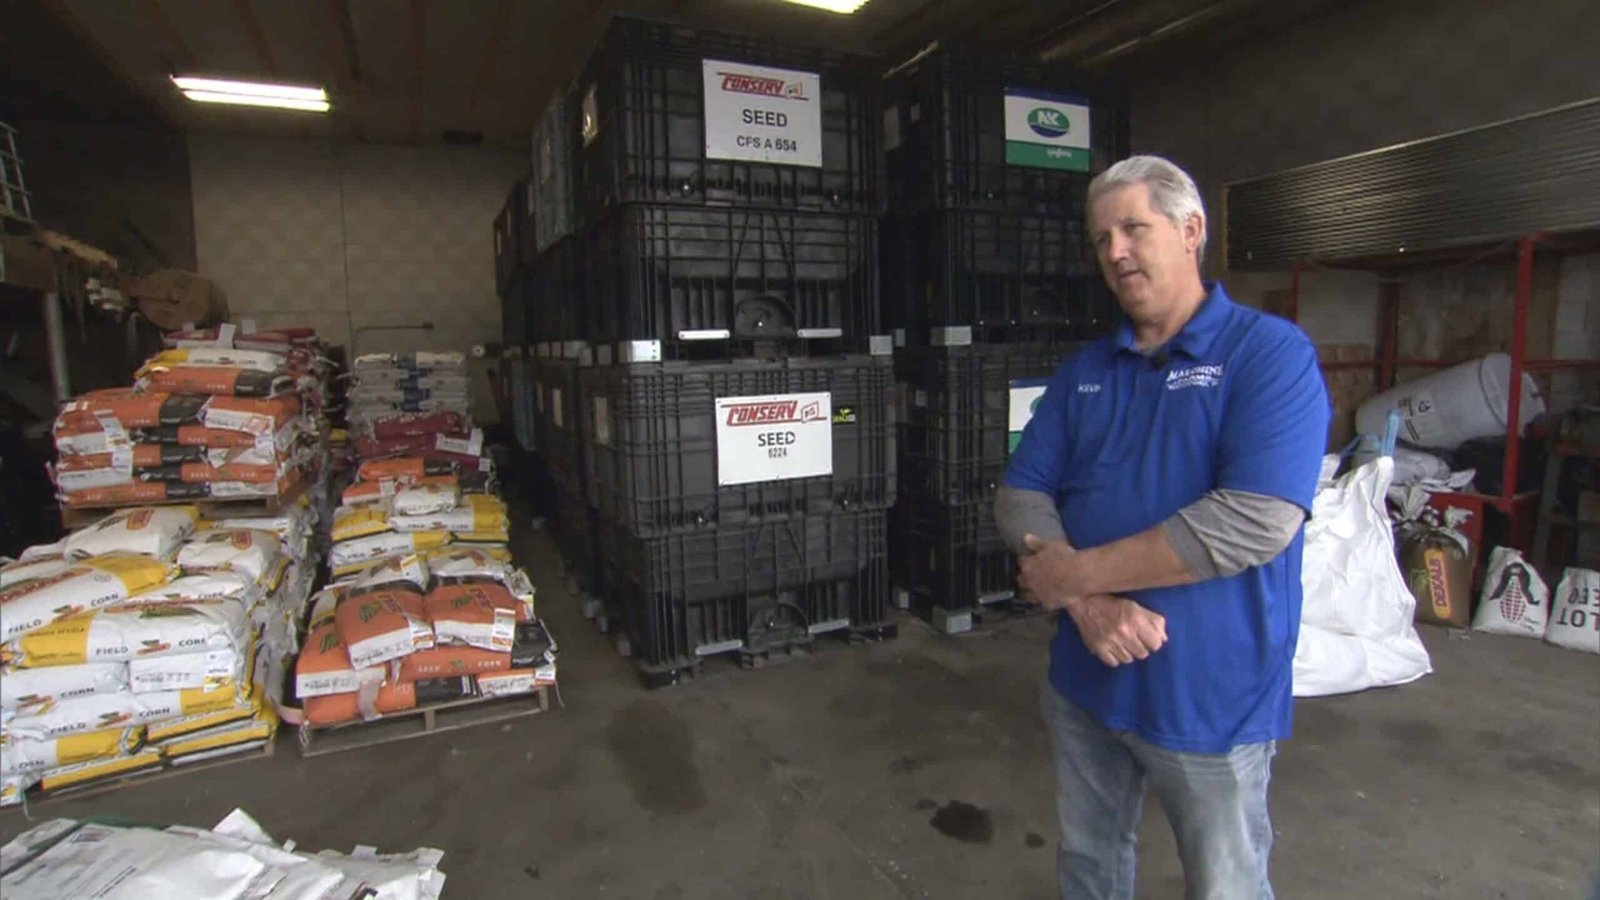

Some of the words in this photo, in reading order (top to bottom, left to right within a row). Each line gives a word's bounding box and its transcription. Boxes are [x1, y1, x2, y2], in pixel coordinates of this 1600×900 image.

[721, 74, 784, 95] CONSERV
[742, 108, 787, 127] SEED
[1037, 109, 1061, 127] NK
[736, 135, 761, 148] CFS
[764, 138, 773, 149] A
[775, 138, 797, 151] 654
[726, 400, 798, 427] CONSERV
[757, 431, 796, 447] SEED
[90, 593, 119, 607] CORN
[96, 646, 128, 655] FIELD
[139, 707, 171, 718] CORN
